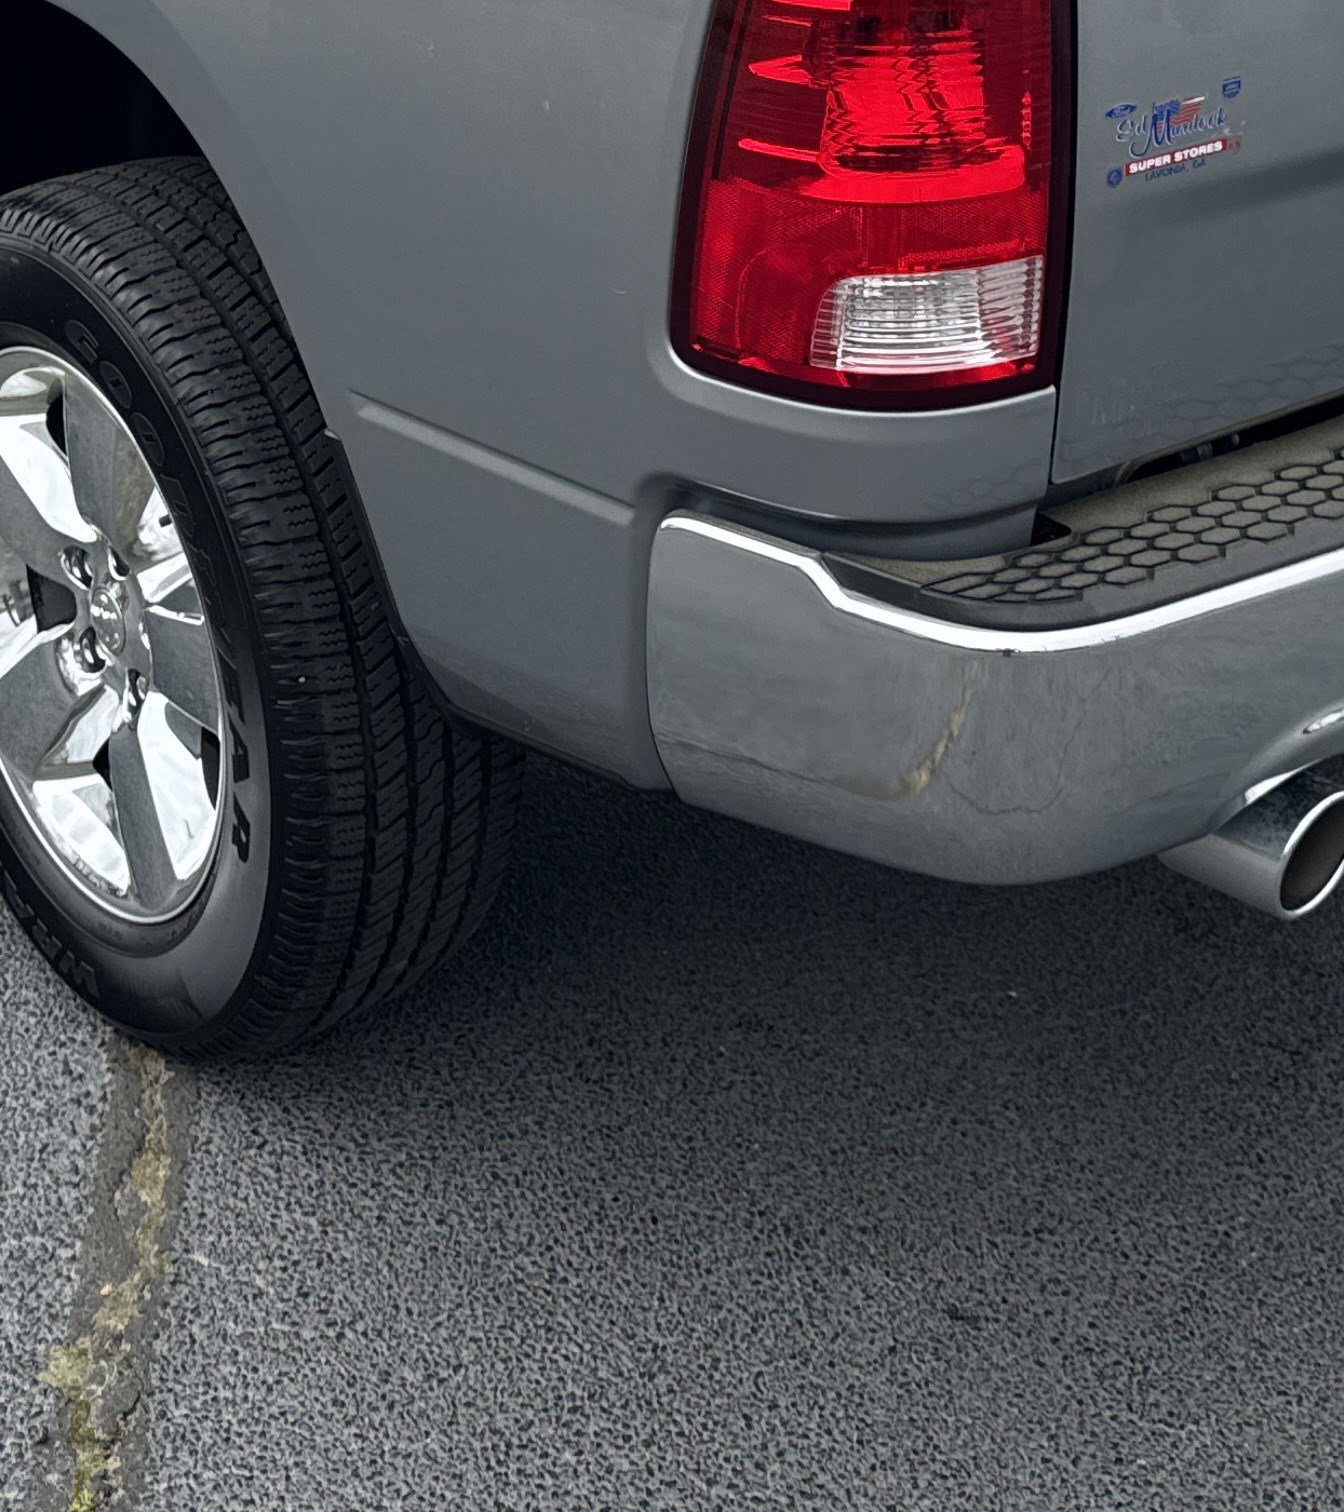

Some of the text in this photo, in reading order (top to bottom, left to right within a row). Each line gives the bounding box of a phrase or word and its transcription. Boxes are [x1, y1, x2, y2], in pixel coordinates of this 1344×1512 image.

[1115, 114, 1147, 143] Ed
[1128, 140, 1224, 175] SUPER STORES
[63, 319, 254, 866] GOODYEAR
